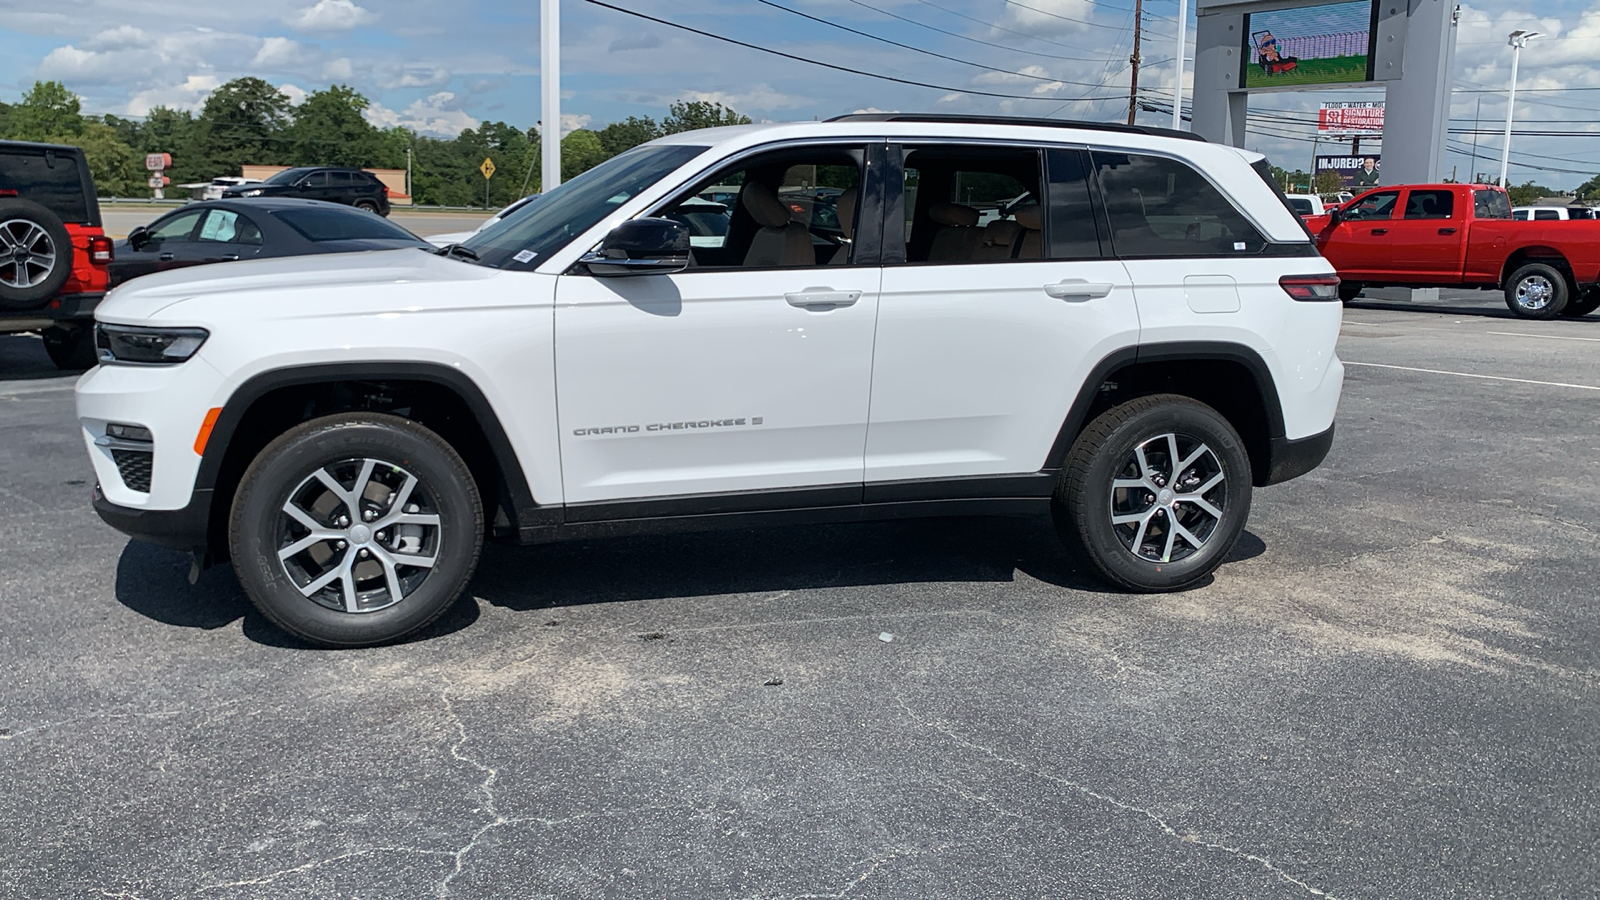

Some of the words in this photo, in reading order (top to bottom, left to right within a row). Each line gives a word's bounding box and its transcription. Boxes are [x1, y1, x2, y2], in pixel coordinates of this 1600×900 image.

[1344, 109, 1385, 117] SIGNATURE
[1343, 117, 1384, 125] RESTORATION
[1318, 158, 1364, 169] INJURED?
[573, 425, 640, 436] GRAND
[646, 418, 746, 431] CHEROKEE
